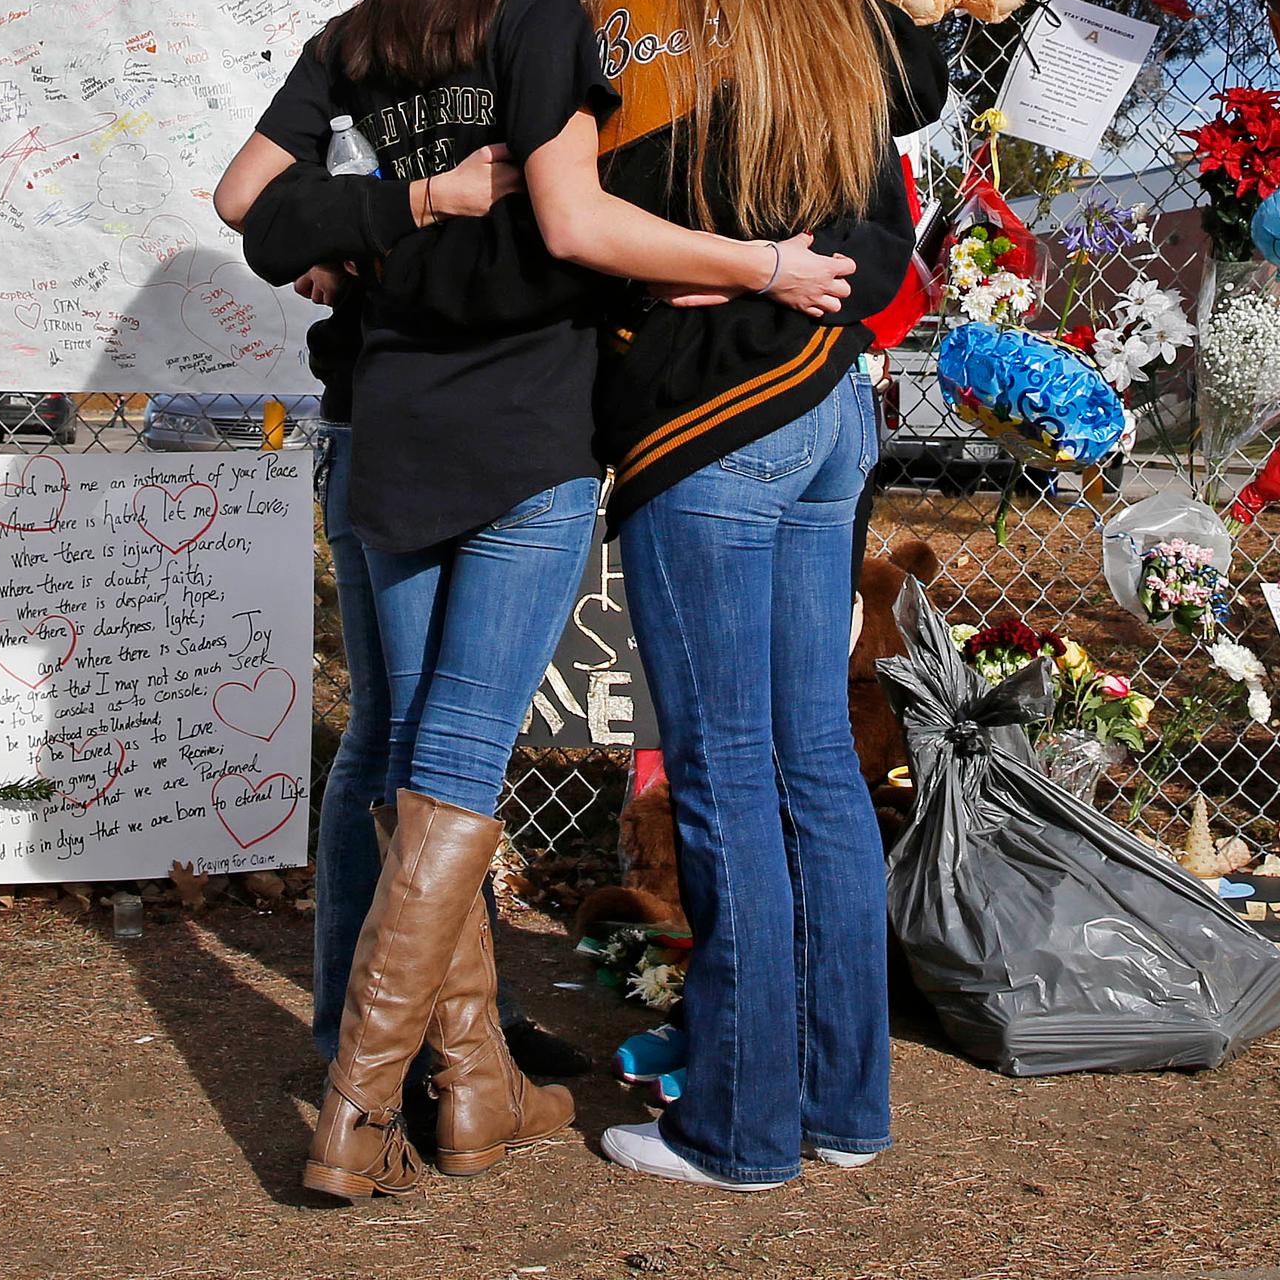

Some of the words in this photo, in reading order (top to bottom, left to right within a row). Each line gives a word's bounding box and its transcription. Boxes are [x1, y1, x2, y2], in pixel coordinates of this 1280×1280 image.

[52, 297, 81, 315] STAY
[3, 472, 37, 499] Lord
[110, 479, 126, 490] an
[207, 463, 224, 489] of
[228, 466, 258, 493] your
[257, 452, 299, 481] Peace
[43, 506, 77, 535] there
[85, 517, 96, 529] is
[162, 490, 187, 523] let
[53, 540, 95, 564] there
[102, 543, 115, 558] is
[121, 539, 164, 573] injury
[36, 572, 74, 595] there
[81, 574, 93, 589] is
[55, 597, 88, 615] there
[96, 596, 106, 610] is
[182, 585, 226, 609] hope;
[35, 622, 68, 641] there
[75, 620, 86, 636] is
[37, 657, 64, 676] and
[117, 645, 151, 663] there
[227, 608, 273, 658] Joy
[19, 683, 59, 715] grant
[63, 678, 92, 699] that
[95, 671, 110, 696] I
[114, 676, 140, 704] may
[147, 666, 169, 688] not
[174, 668, 190, 682] so
[194, 660, 222, 678] much
[40, 838, 52, 854] in
[56, 828, 85, 860] dying
[89, 819, 121, 842] that
[127, 820, 143, 833] we
[150, 814, 173, 828] are
[212, 796, 227, 811] to
[235, 784, 273, 807] eternal
[280, 775, 309, 801] Life
[196, 856, 230, 876] Praying
